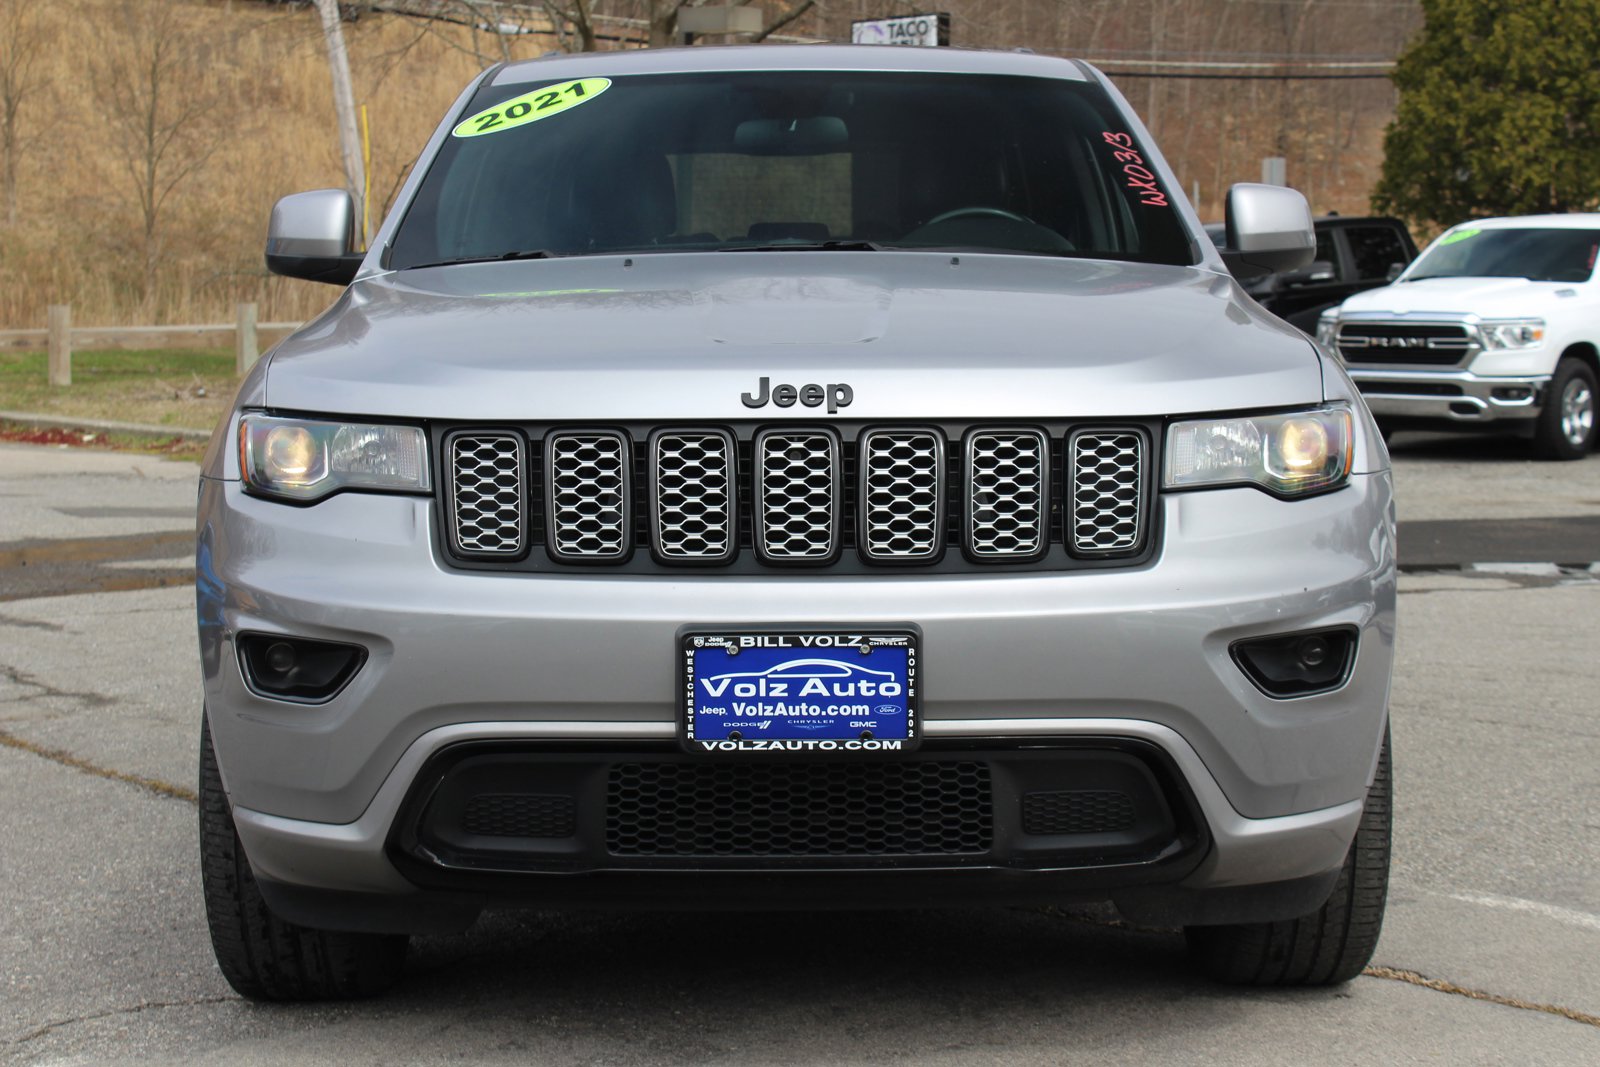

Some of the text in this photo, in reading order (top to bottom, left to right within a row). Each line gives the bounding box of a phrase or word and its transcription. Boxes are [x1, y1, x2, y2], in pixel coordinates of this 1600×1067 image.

[887, 20, 929, 39] TACO
[474, 82, 586, 132] 2021
[740, 376, 854, 414] Jeep
[740, 635, 862, 648] BILL VOLZ
[686, 650, 695, 739] WESTCHESTER
[700, 678, 901, 697] Volz Auto
[699, 705, 726, 716] Jeep
[732, 702, 870, 717] VolzAuto.com
[702, 740, 902, 751] VOLZAUTO.COM
